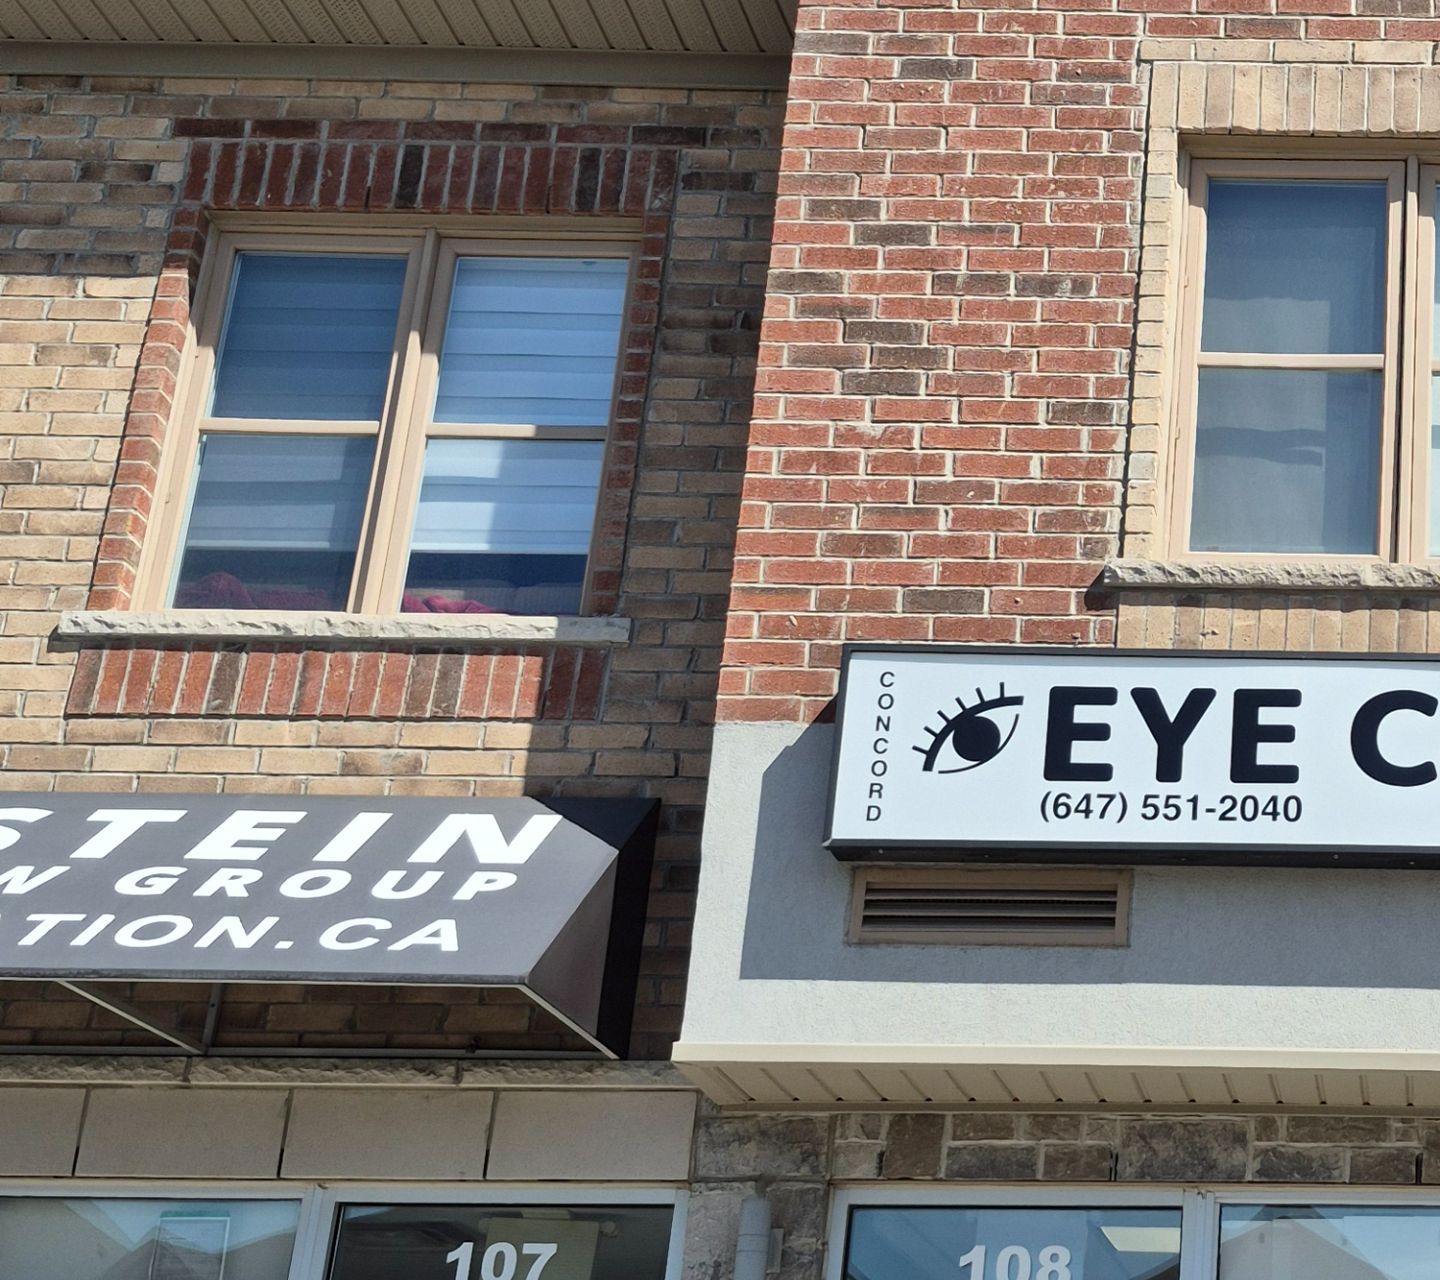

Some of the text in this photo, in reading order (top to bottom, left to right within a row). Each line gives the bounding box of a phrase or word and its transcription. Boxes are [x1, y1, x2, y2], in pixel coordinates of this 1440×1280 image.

[866, 671, 894, 822] CONCORD
[1043, 686, 1302, 784] EYE
[1039, 792, 1302, 826] (647) 551-2040
[114, 866, 517, 900] GROUP
[17, 913, 460, 952] TION.CA
